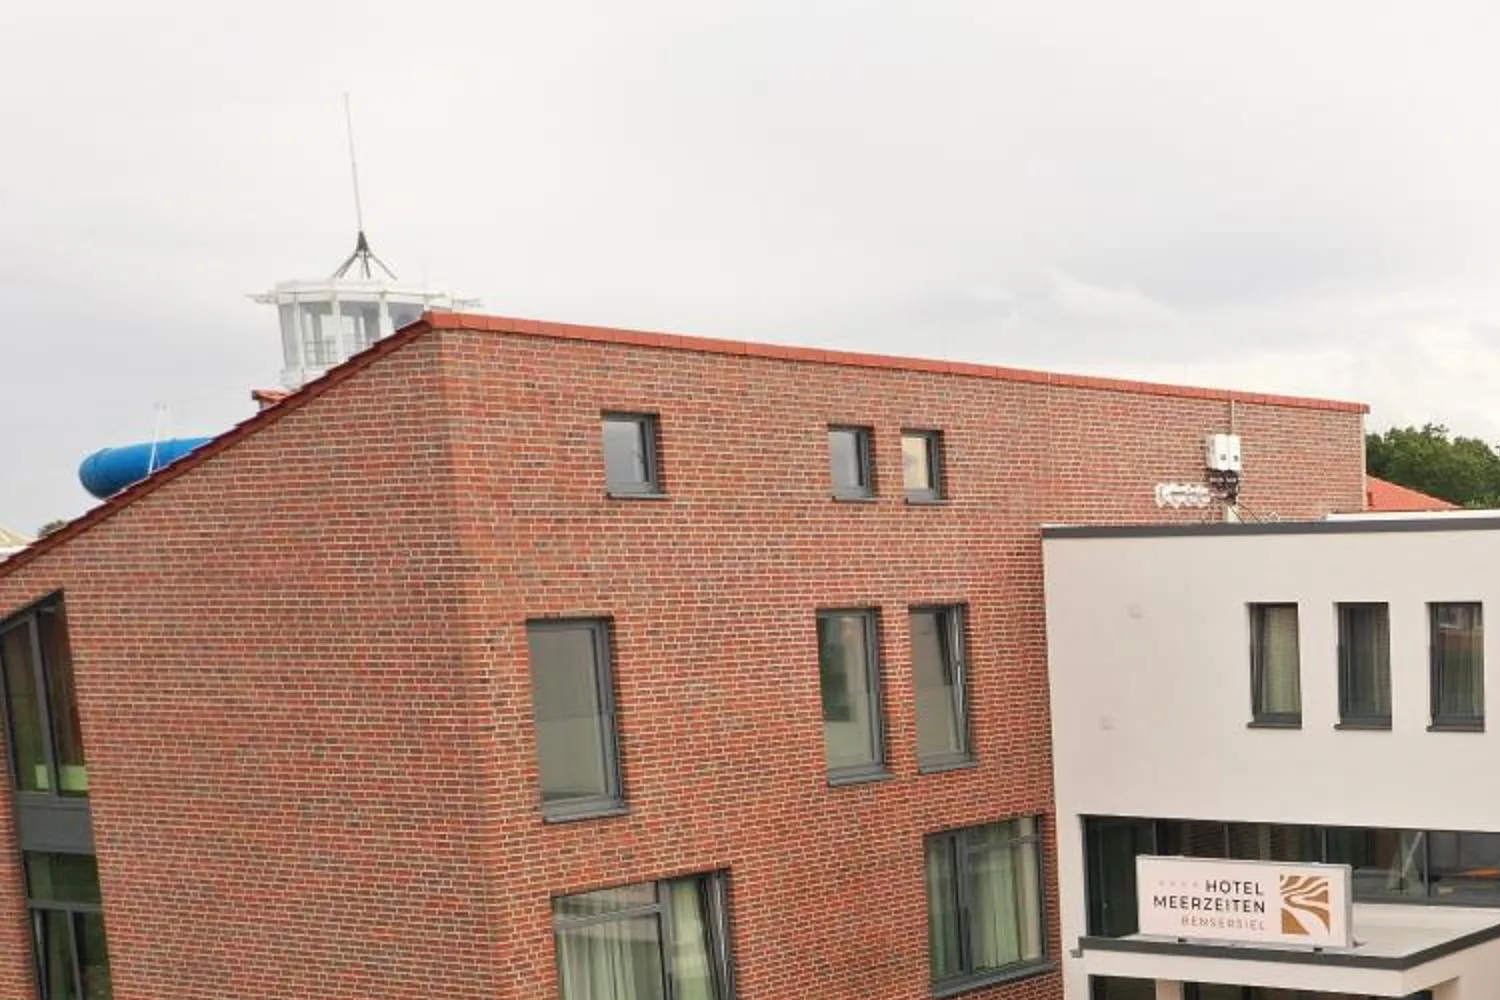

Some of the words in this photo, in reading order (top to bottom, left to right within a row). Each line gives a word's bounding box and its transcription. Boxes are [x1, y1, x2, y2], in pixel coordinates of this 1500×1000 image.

[1205, 879, 1264, 896] HOTEL
[1153, 895, 1265, 914] MEERZEITEN
[1181, 915, 1265, 931] BENSERSIEL
